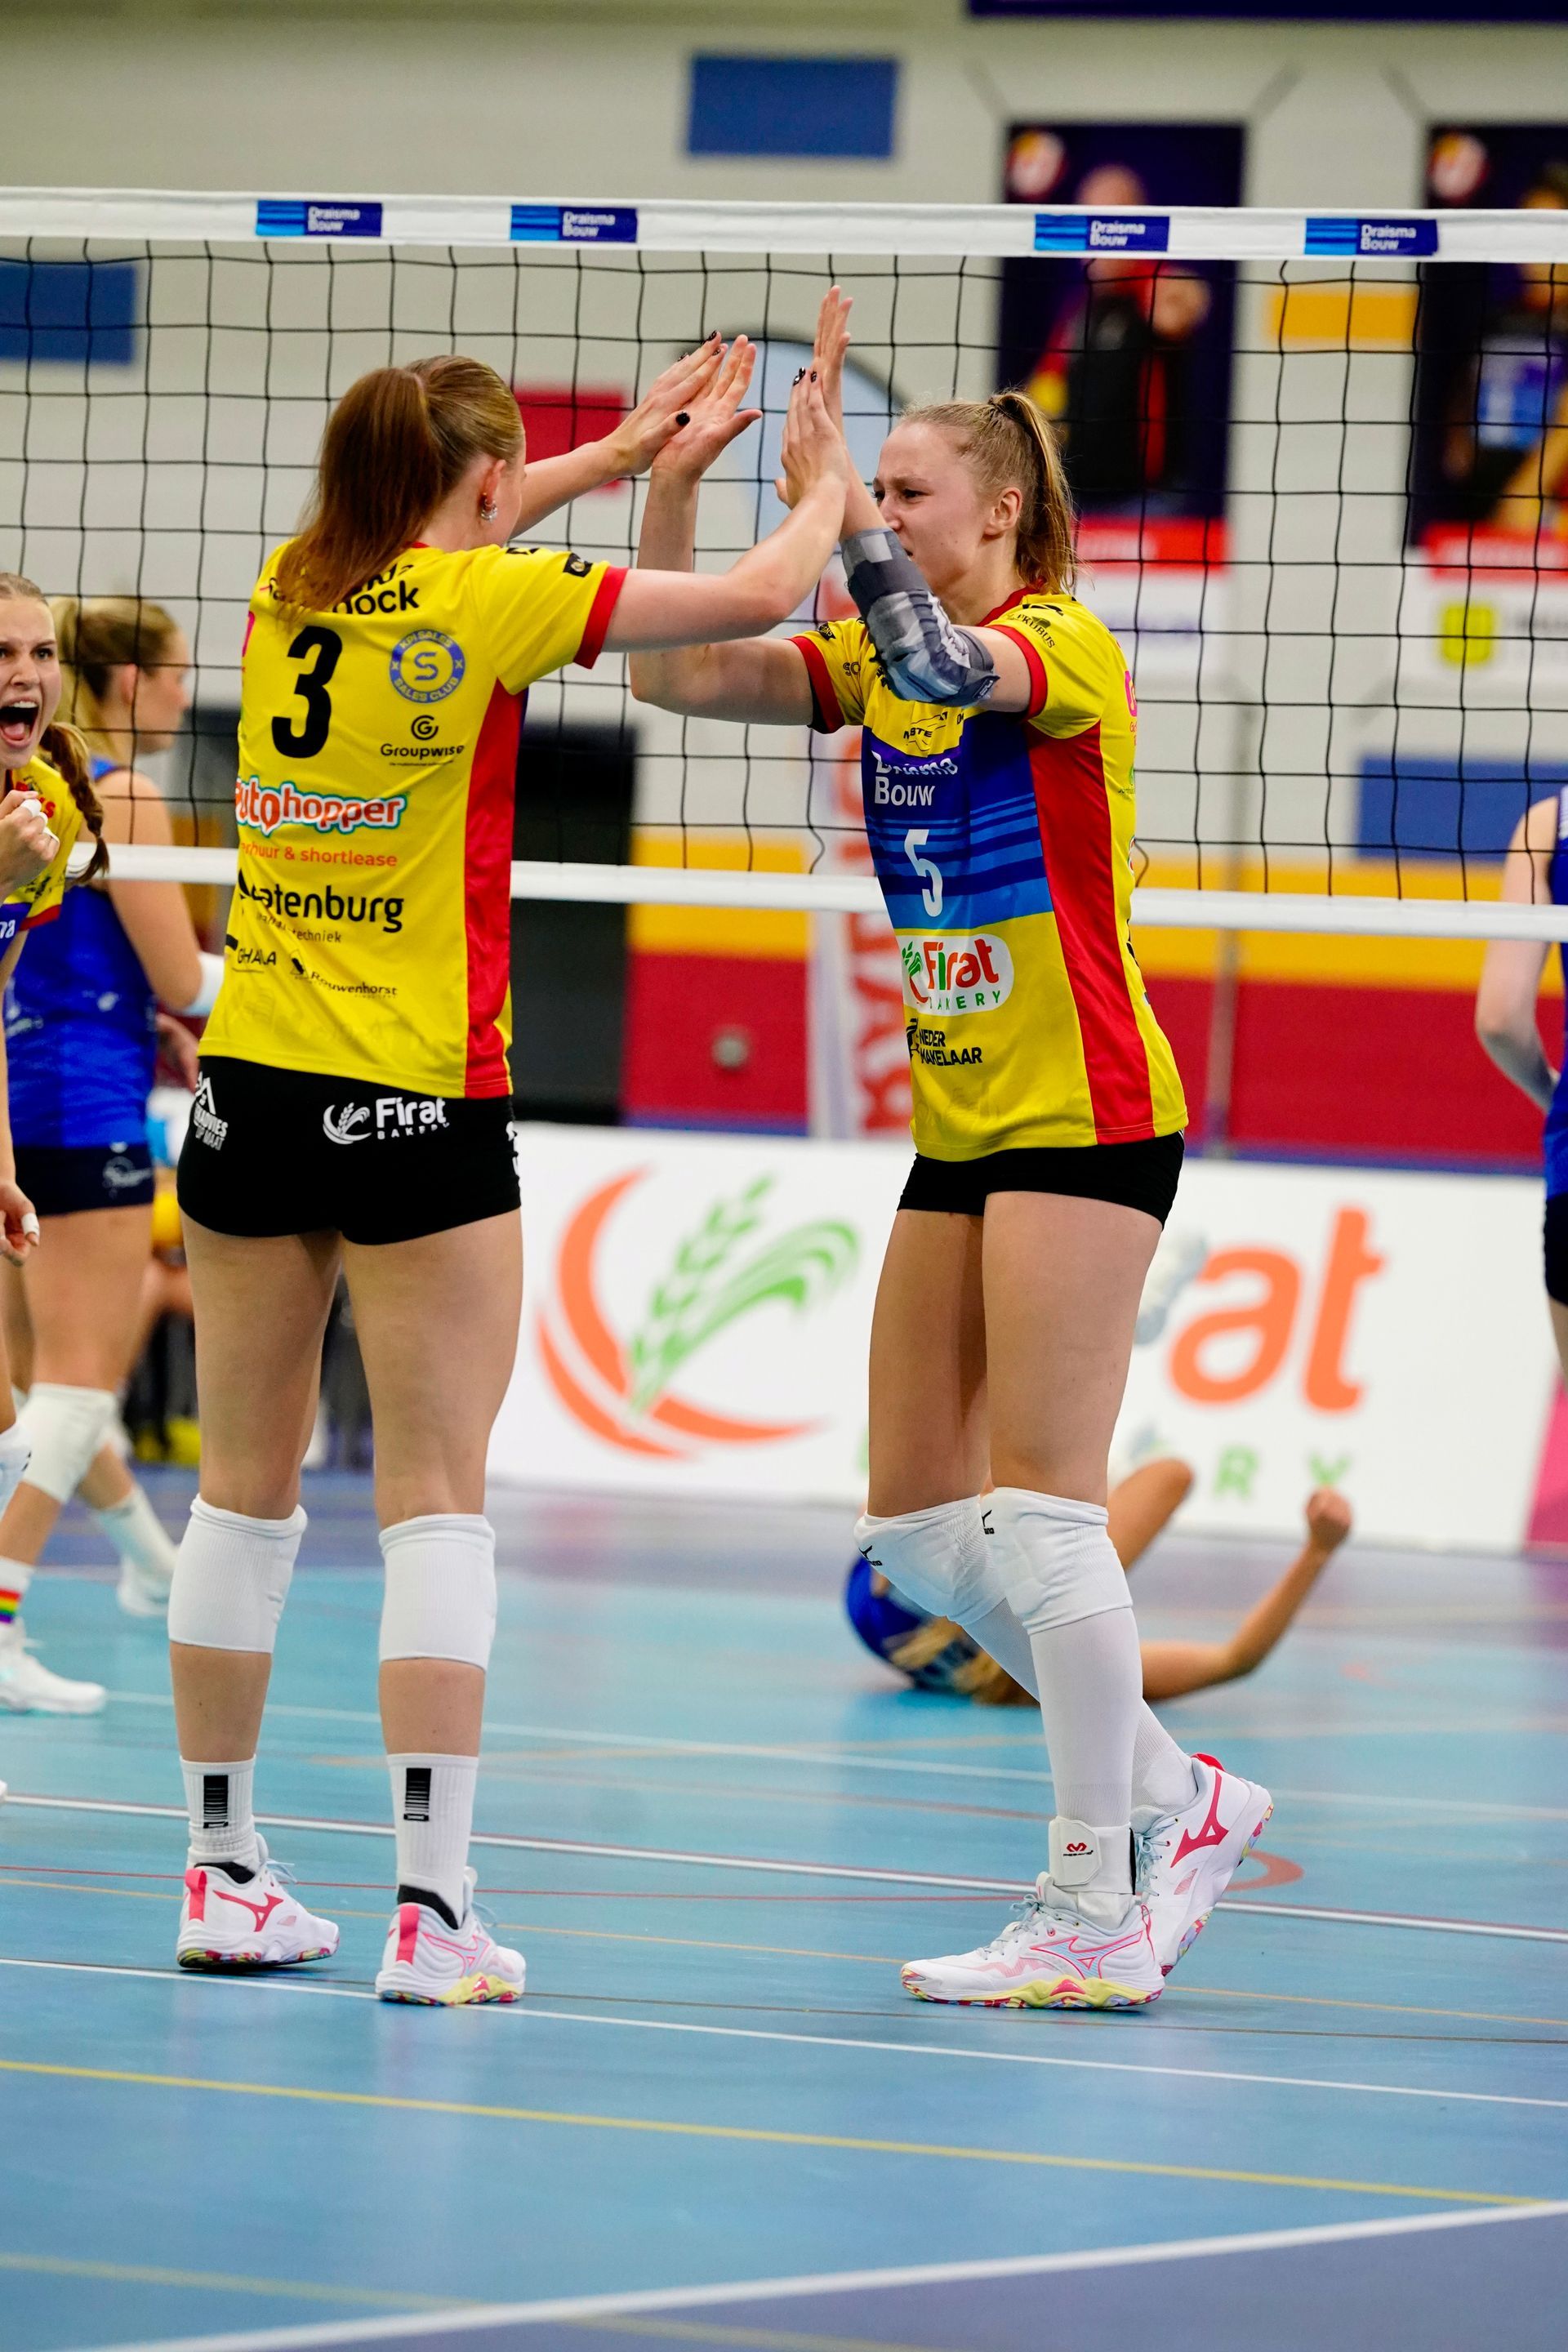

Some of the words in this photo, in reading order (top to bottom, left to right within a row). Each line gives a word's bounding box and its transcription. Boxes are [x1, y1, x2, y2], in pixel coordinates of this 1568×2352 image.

[308, 205, 360, 221] Draisma
[563, 211, 616, 225] Draisma
[307, 220, 344, 232] Bouw
[562, 224, 599, 237] Bouw
[1091, 220, 1146, 235] Draisma
[1361, 224, 1417, 238] Draisma
[1089, 233, 1128, 246] Bouw
[1361, 237, 1399, 251] Bouw
[271, 625, 343, 759] 3
[381, 743, 465, 760] Groupwise
[874, 776, 935, 806] Bouw
[284, 845, 296, 861] &
[301, 847, 398, 866] shortlease
[904, 829, 943, 917] 5
[923, 938, 1000, 991] Firat
[311, 970, 399, 996] Rouwenhorst
[375, 1097, 448, 1129] Firat
